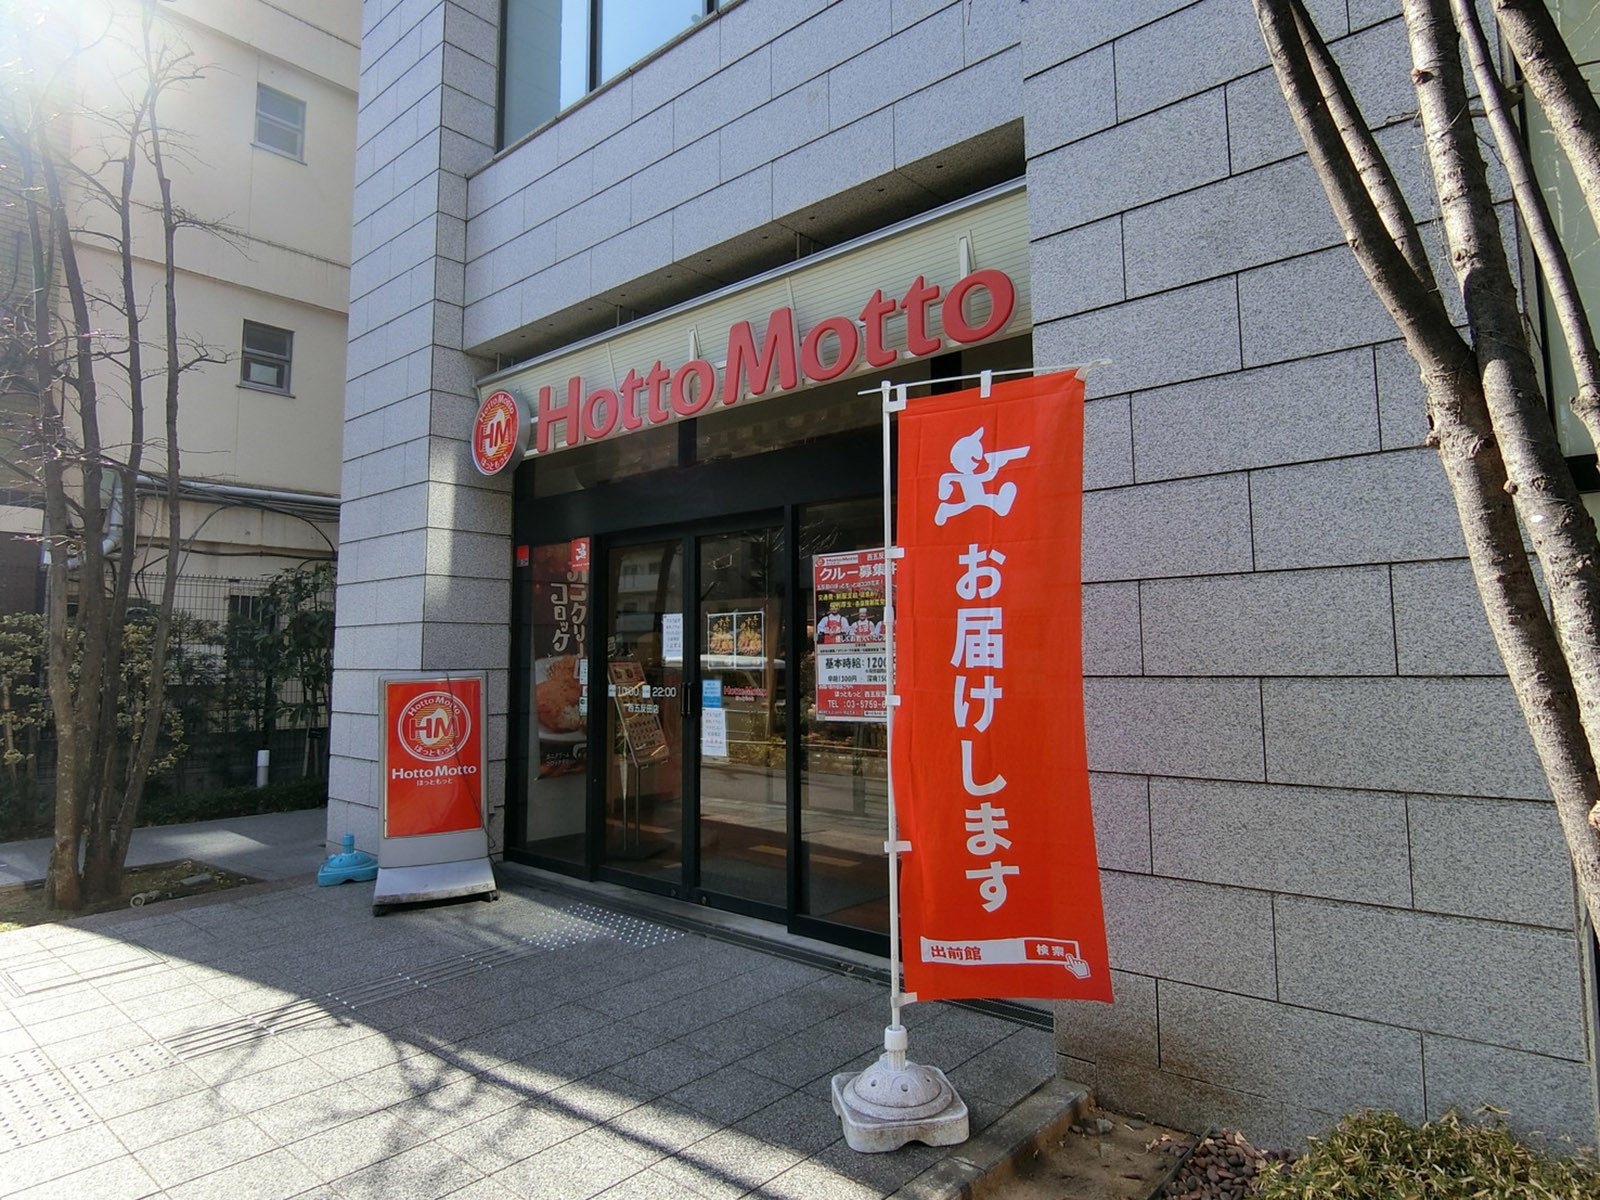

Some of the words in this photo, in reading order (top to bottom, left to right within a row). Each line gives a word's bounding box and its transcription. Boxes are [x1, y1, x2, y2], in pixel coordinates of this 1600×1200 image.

[819, 562, 897, 581] クルー募集
[550, 582, 571, 652] コロッケ
[652, 687, 677, 698] 22:00
[828, 700, 839, 708] TEL
[951, 543, 1020, 914] お届けします
[414, 743, 456, 757] ほっともっと
[416, 778, 454, 787] ほっともっと
[931, 945, 982, 961] 出前館
[1036, 943, 1065, 957] 検索
